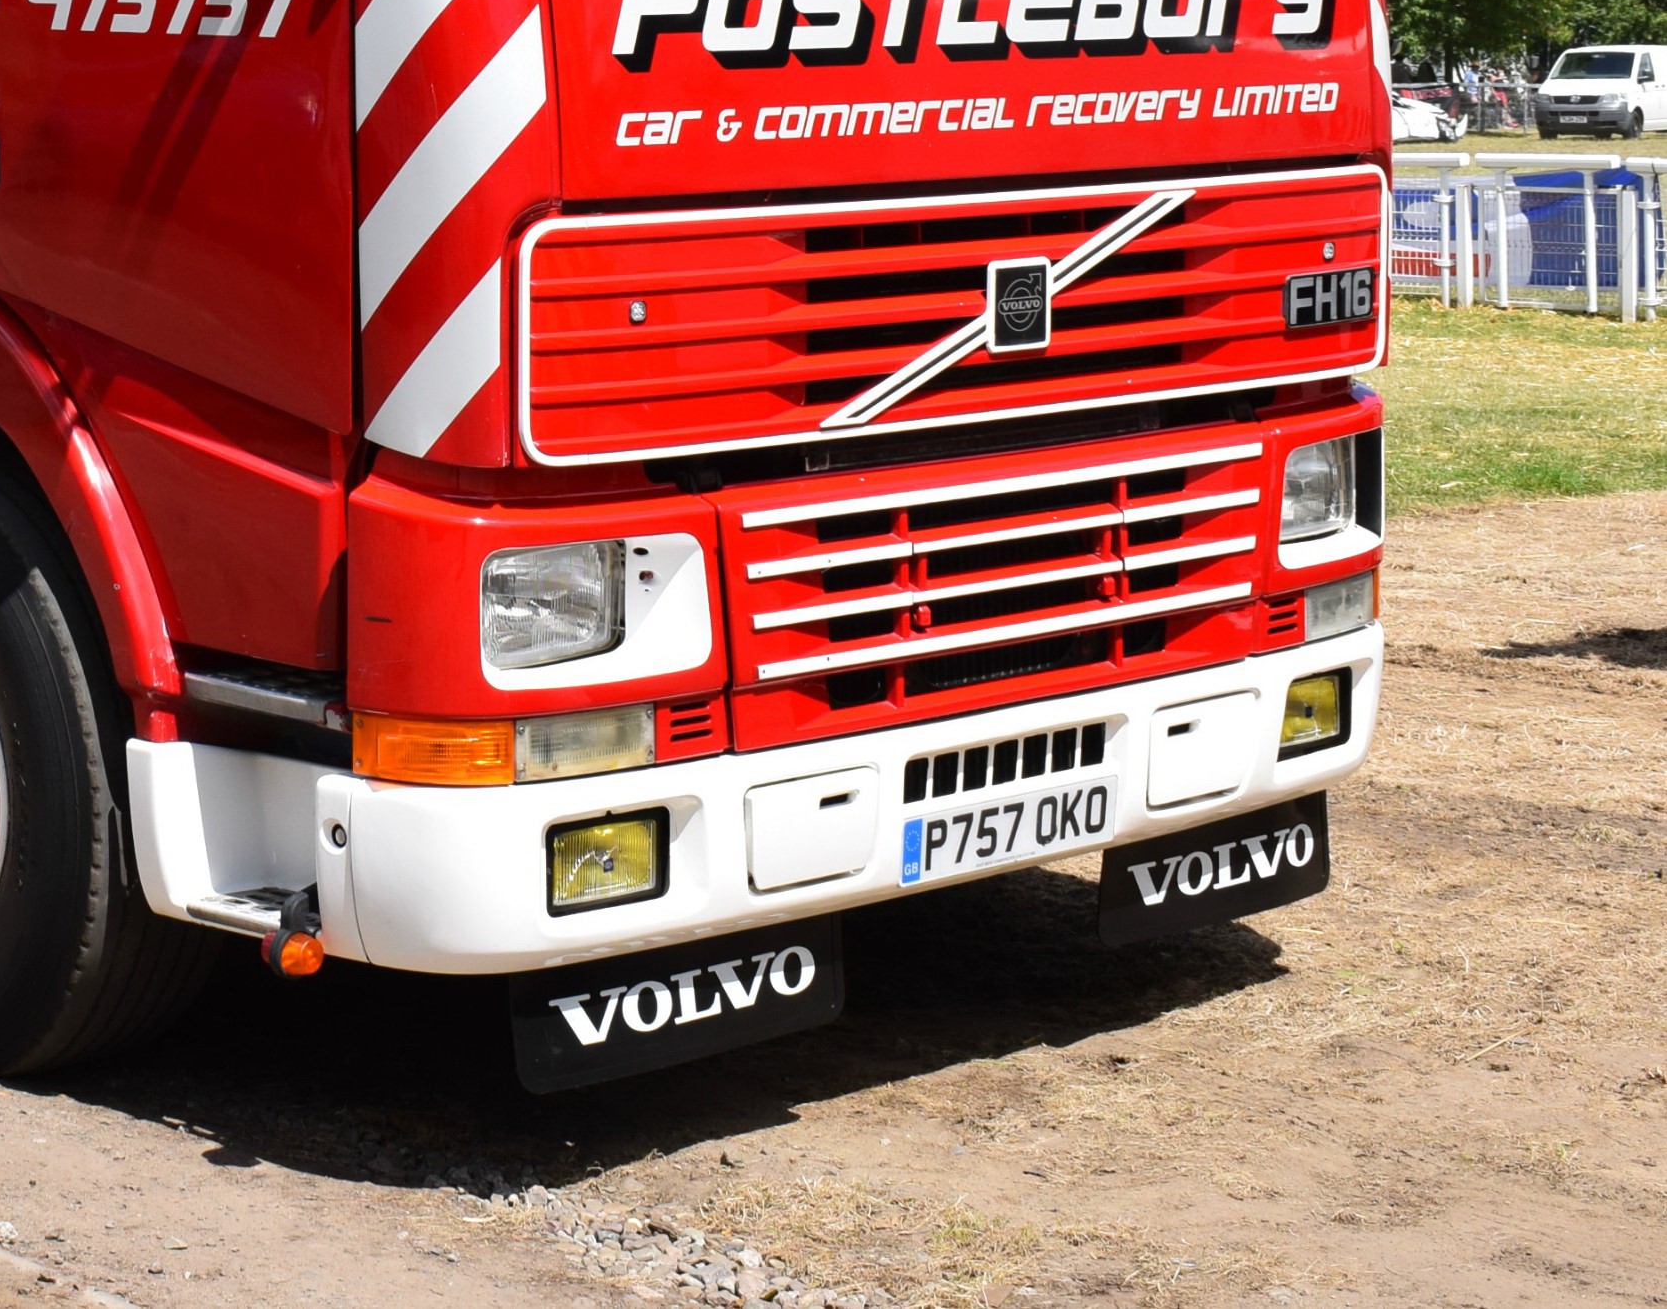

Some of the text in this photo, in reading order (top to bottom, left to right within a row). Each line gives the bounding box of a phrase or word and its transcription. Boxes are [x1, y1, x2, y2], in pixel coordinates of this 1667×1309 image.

[716, 108, 742, 143] &
[1001, 299, 1040, 311] VOLVO
[1290, 270, 1371, 324] FH16
[925, 786, 1107, 871] P757 OKO
[904, 863, 918, 876] GB
[1127, 823, 1314, 907] VOLVO
[548, 945, 816, 1046] VOLVO
